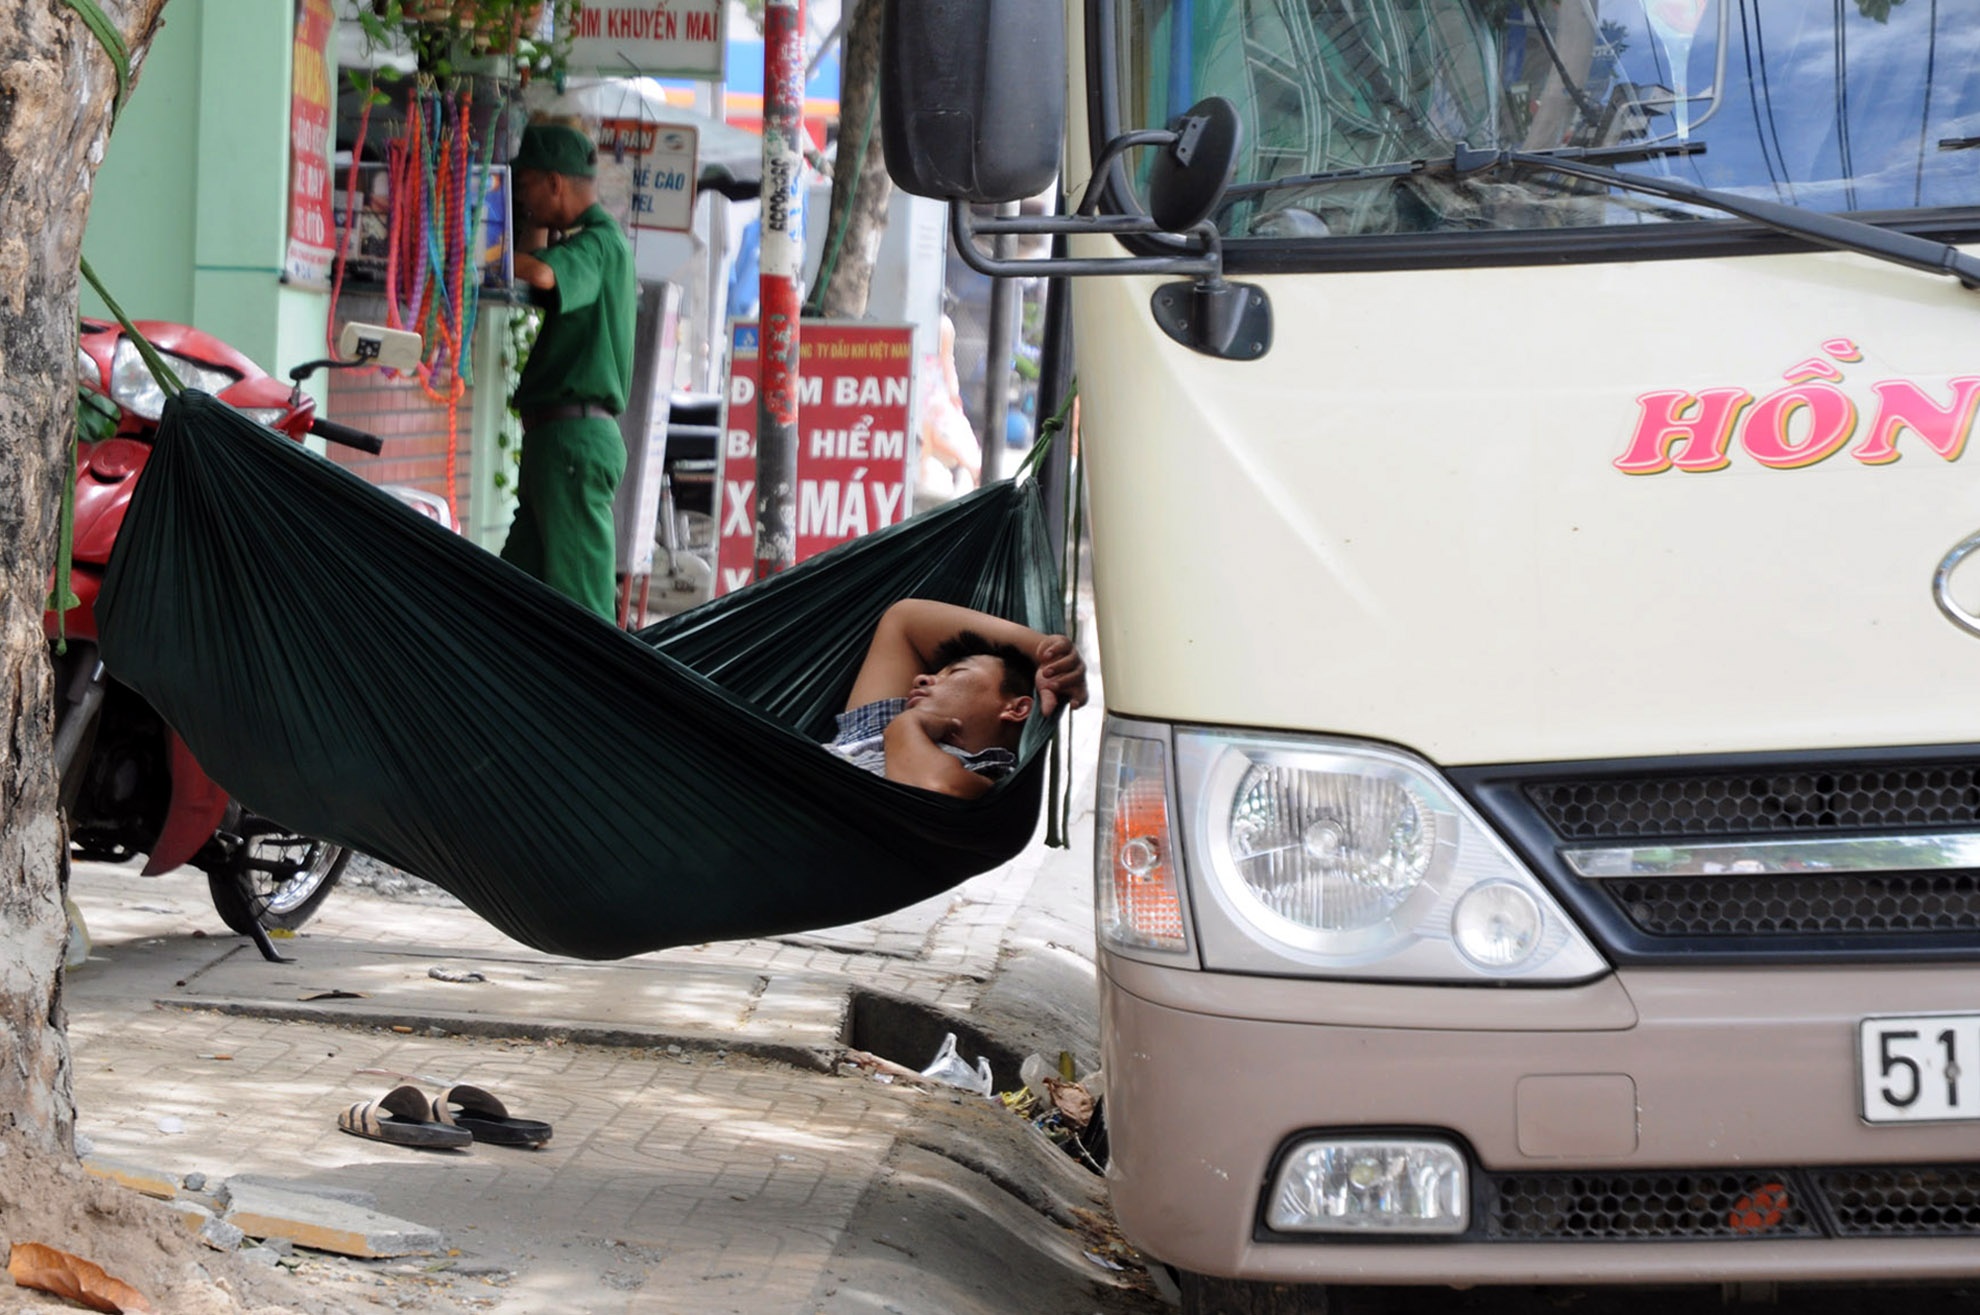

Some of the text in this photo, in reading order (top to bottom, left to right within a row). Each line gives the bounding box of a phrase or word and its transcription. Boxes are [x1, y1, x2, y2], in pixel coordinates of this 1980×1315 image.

[608, 0, 677, 40] KHUYẾN
[817, 342, 830, 359] TY
[731, 376, 823, 405] ĐM
[810, 414, 904, 459] HIỂM
[723, 467, 904, 538] X MÁY
